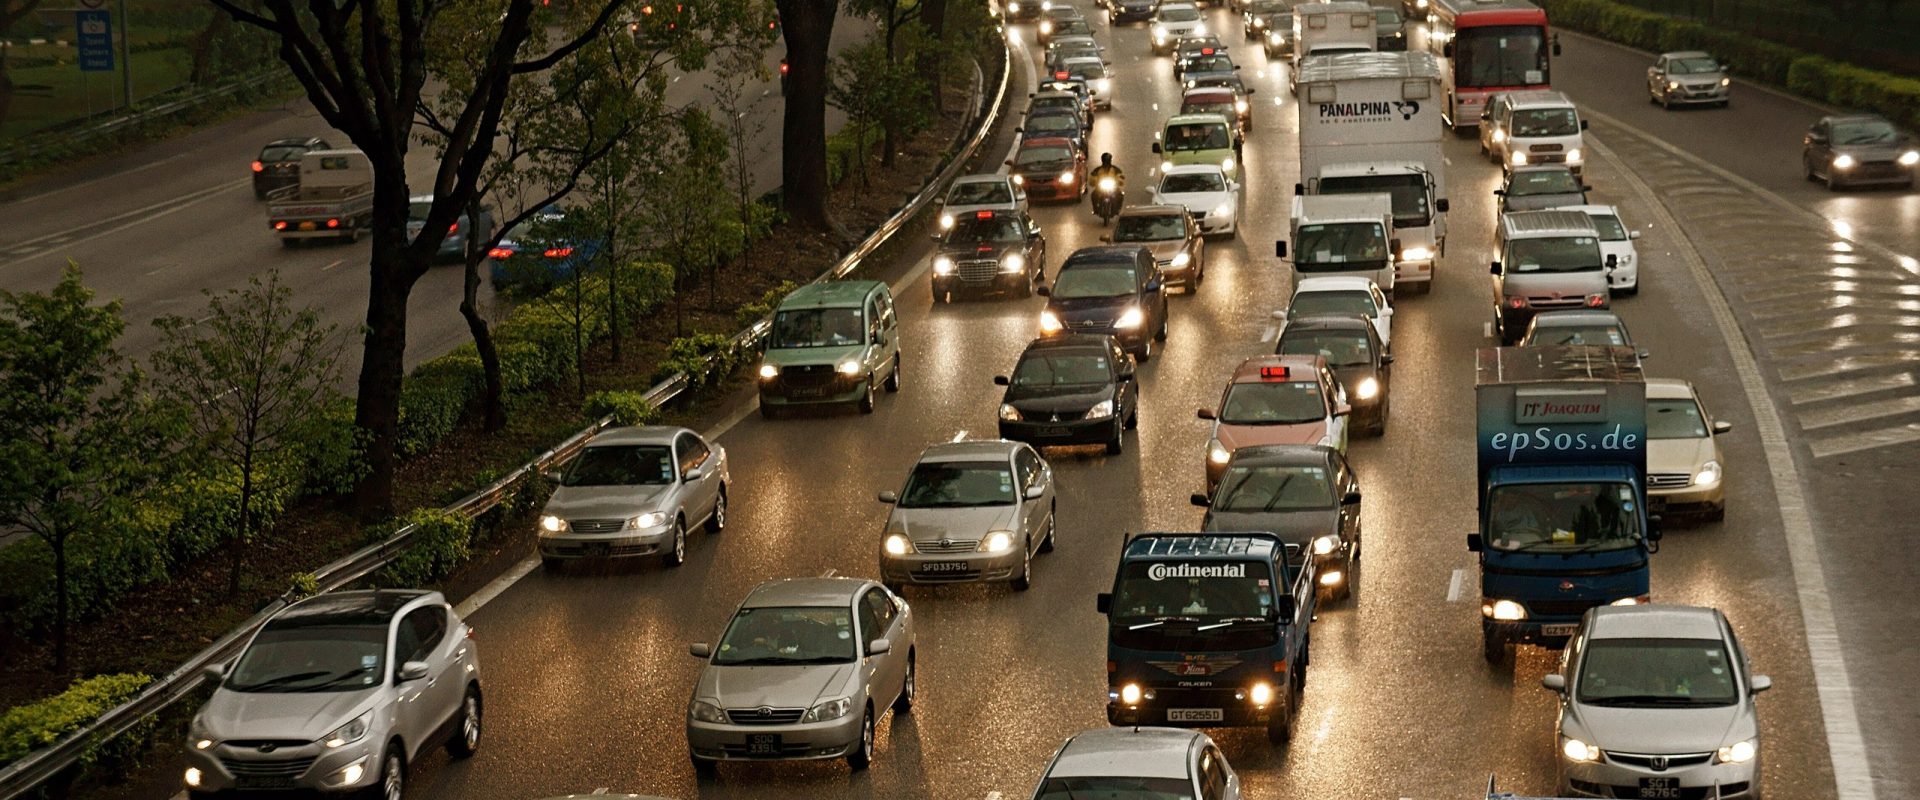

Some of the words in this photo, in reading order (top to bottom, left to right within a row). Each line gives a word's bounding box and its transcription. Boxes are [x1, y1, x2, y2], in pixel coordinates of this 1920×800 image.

[1320, 101, 1391, 117] PANALPINA
[1148, 563, 1246, 581] Continental
[1648, 778, 1670, 788] SGT
[1641, 787, 1679, 798] 9676C
